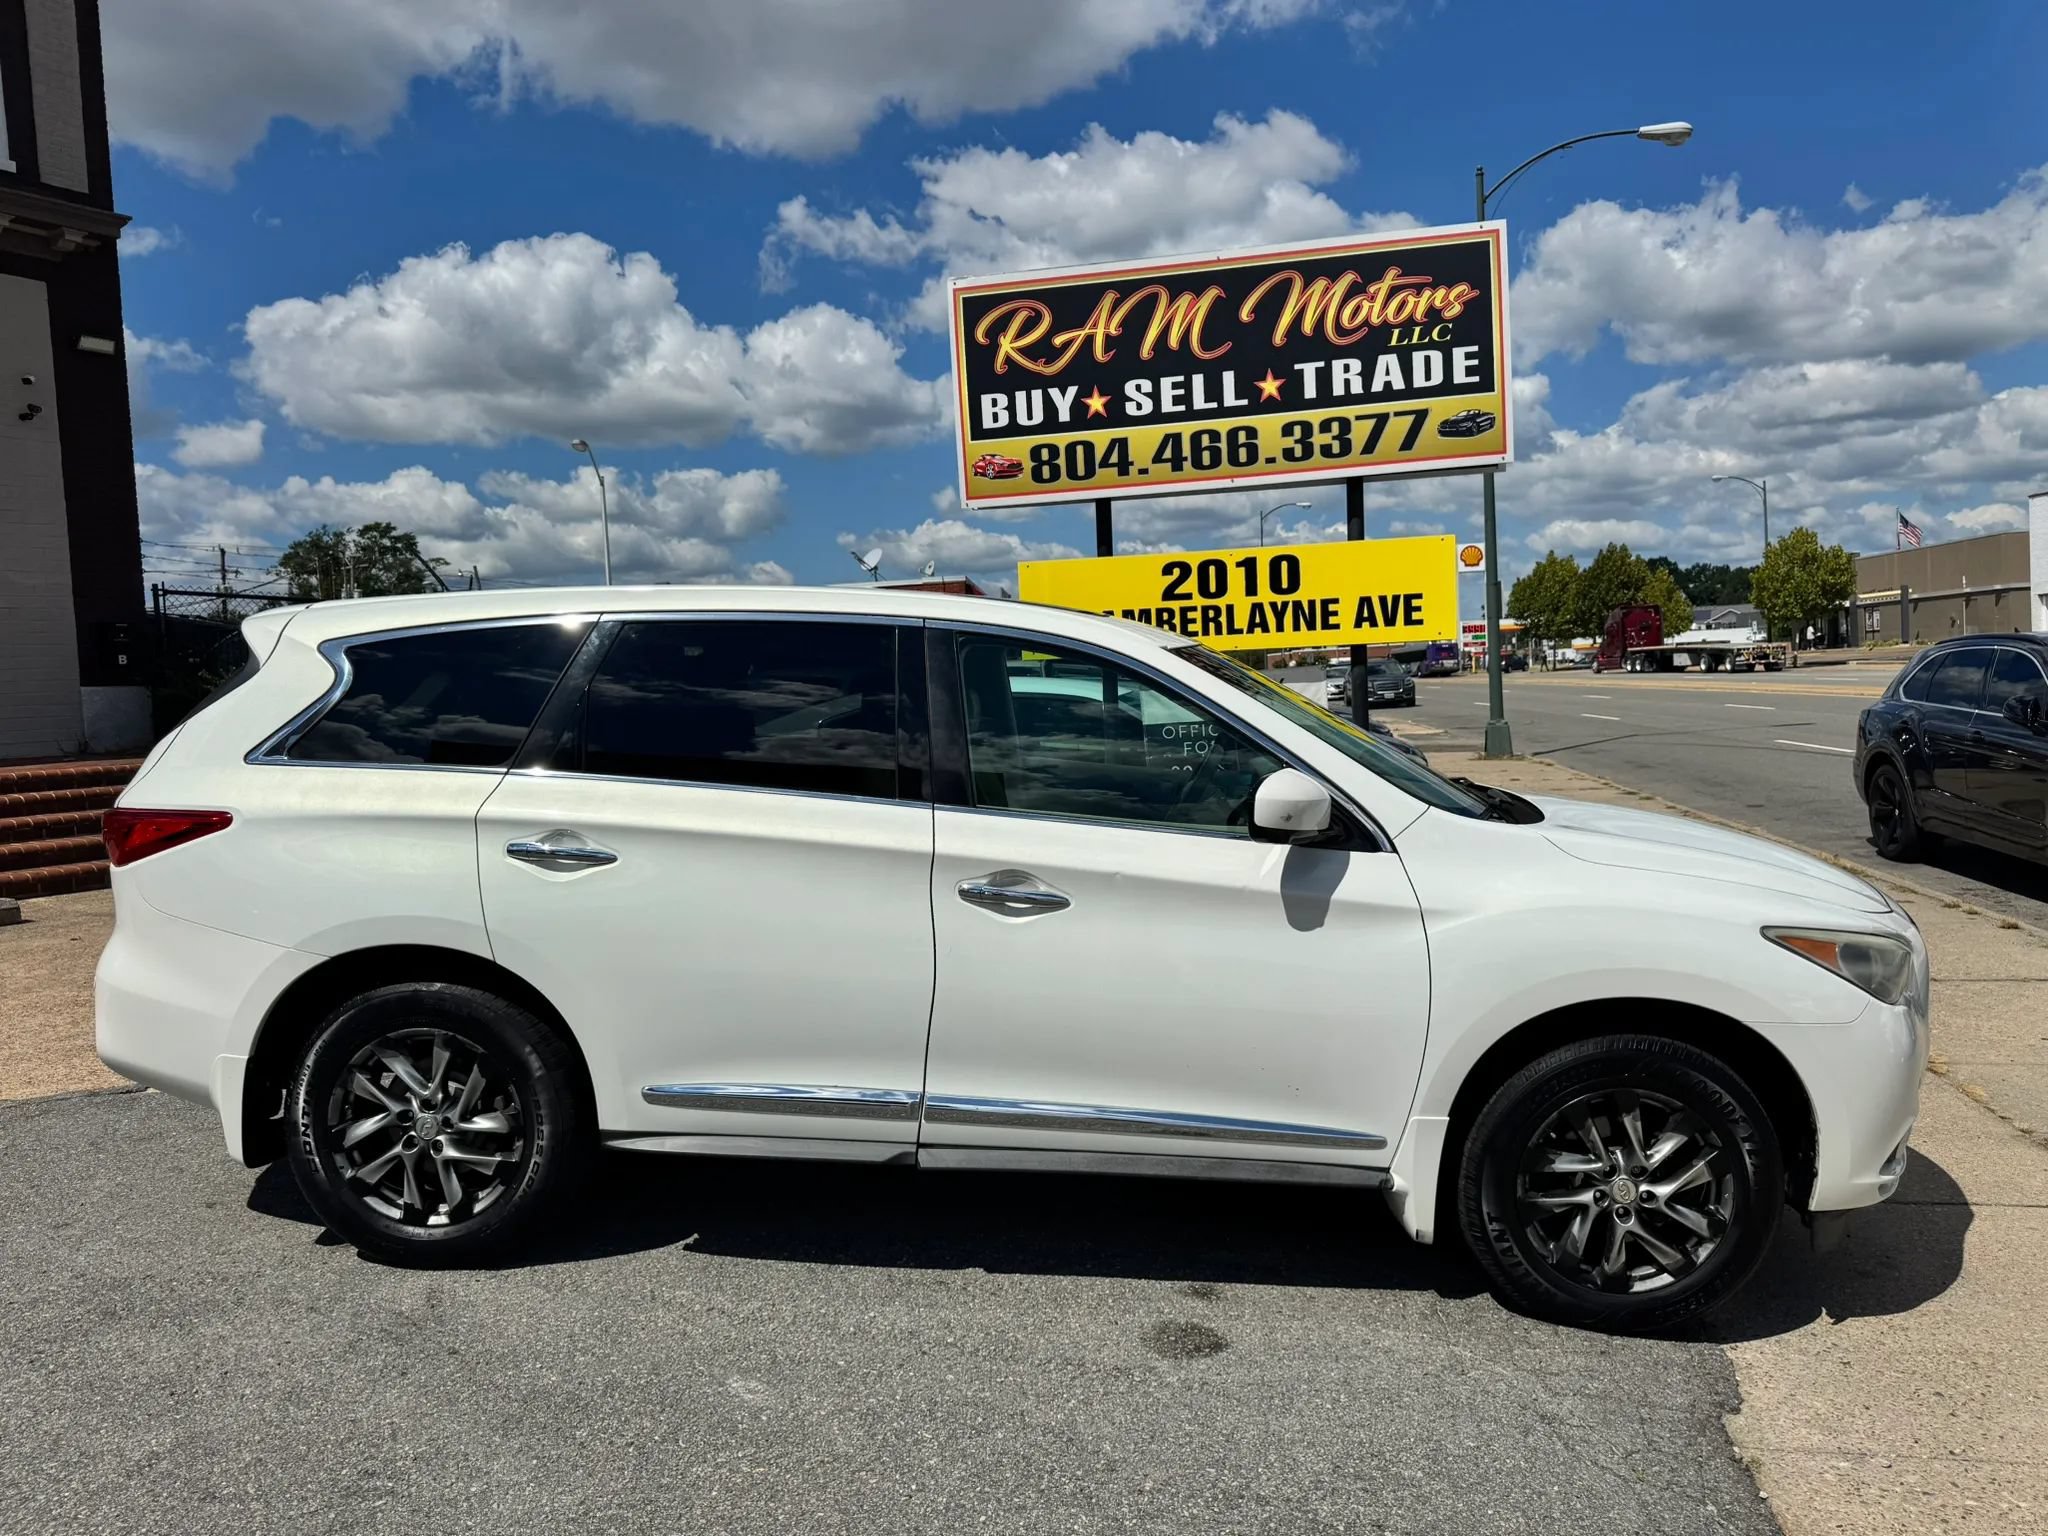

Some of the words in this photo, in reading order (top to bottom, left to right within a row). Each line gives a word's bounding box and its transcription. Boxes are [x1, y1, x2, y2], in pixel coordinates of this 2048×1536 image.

[975, 285, 1233, 375] RAM
[1239, 266, 1480, 346] Motors
[1387, 323, 1453, 347] LLC
[980, 385, 1079, 429] BUY
[1124, 371, 1248, 416] SELL
[1294, 345, 1480, 400] TRADE
[1030, 408, 1432, 484] 804.466.3377
[1161, 553, 1301, 602] 2010
[1102, 598, 1341, 638] BERLAYNE
[1353, 593, 1424, 629] AVE
[118, 654, 128, 665] B
